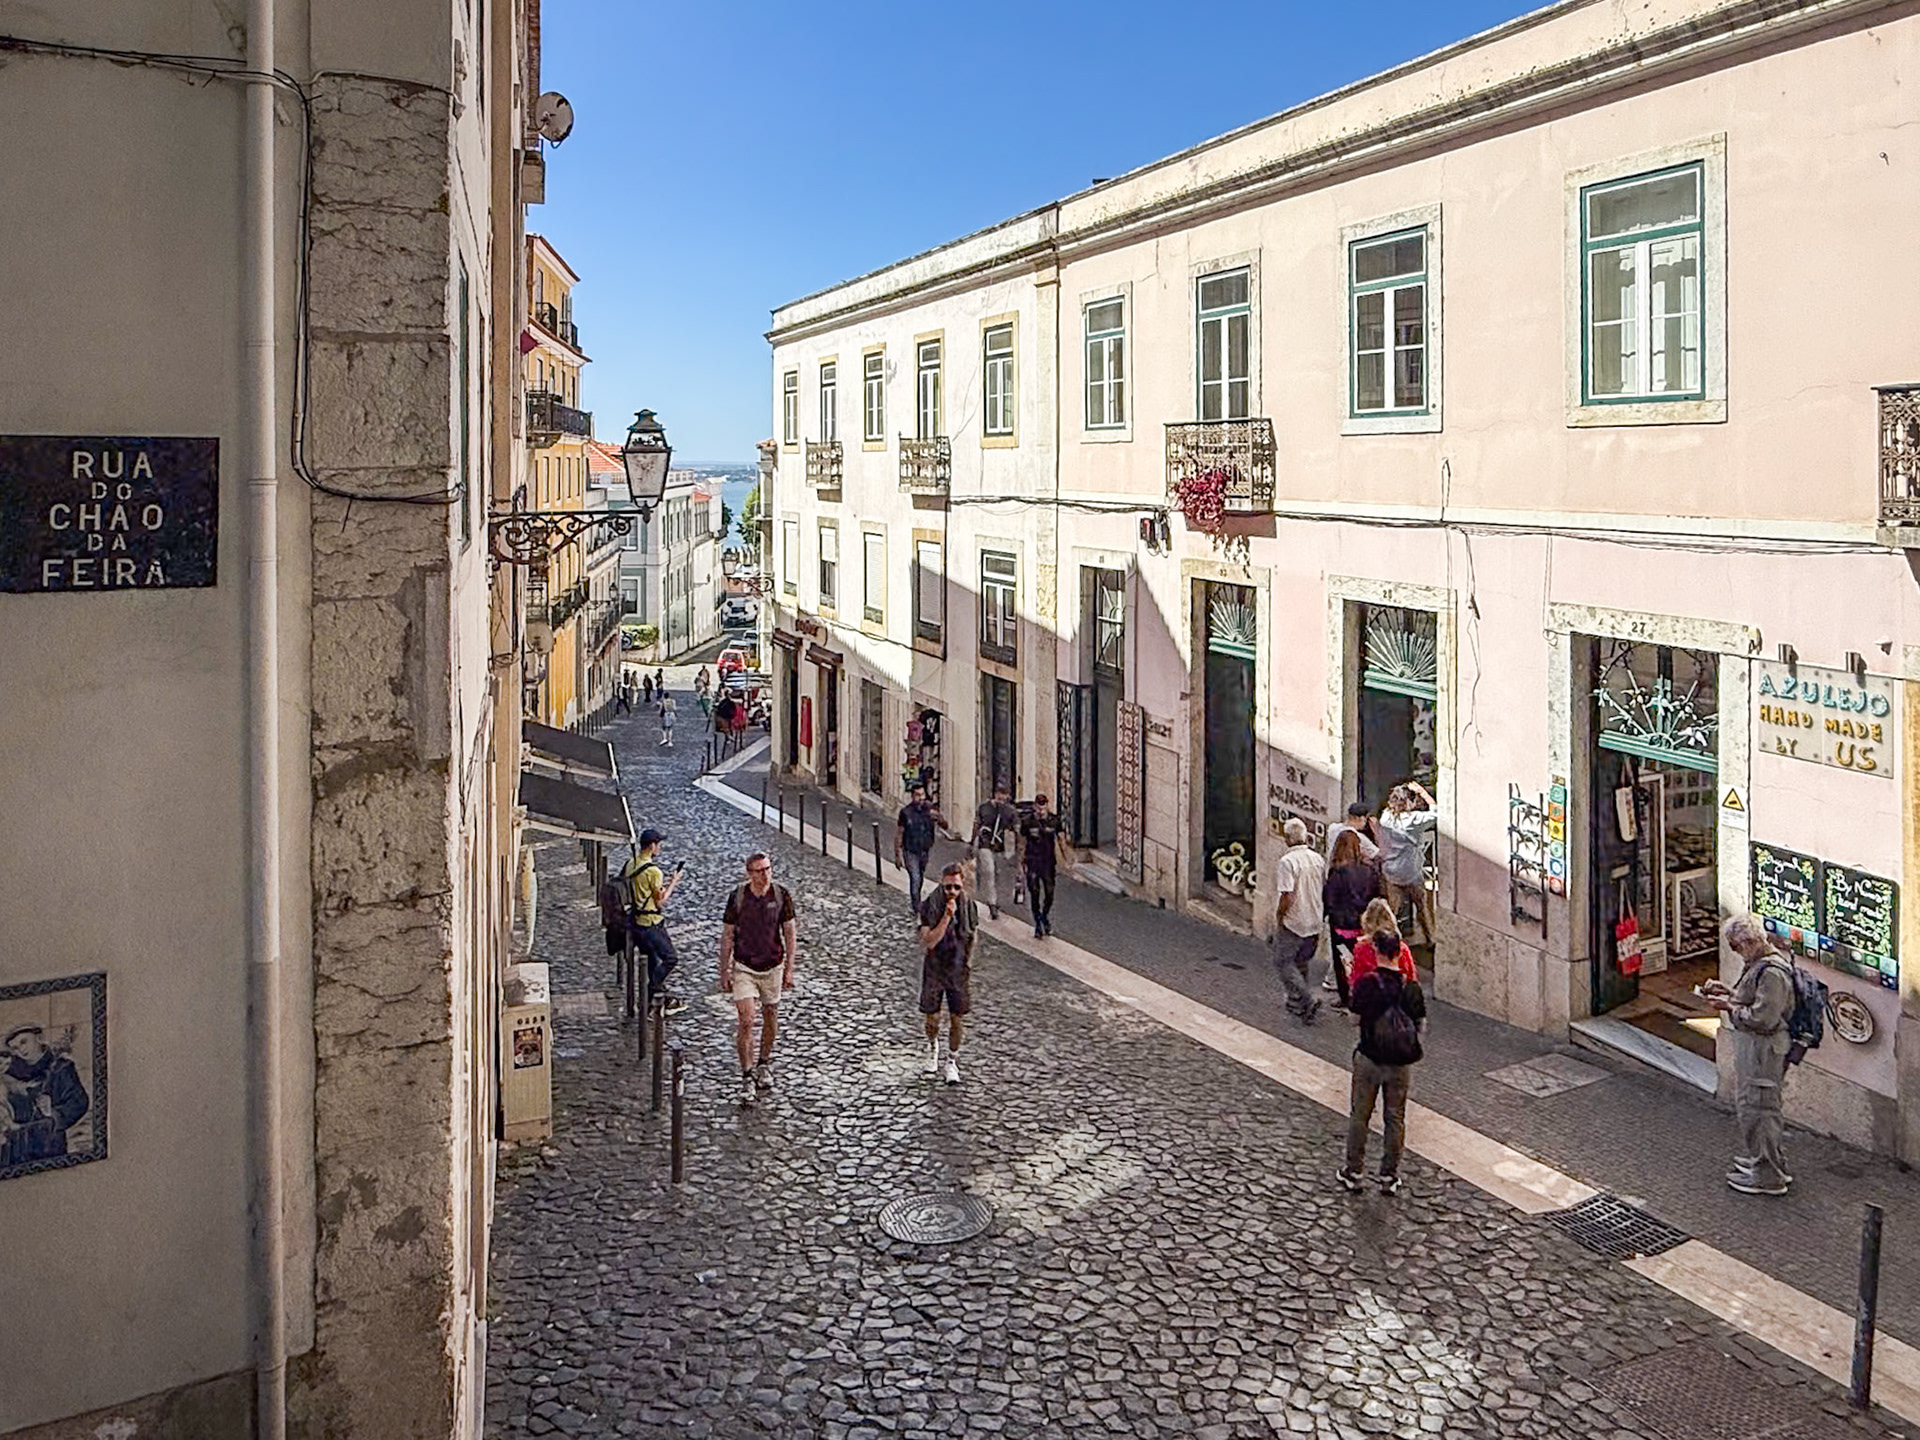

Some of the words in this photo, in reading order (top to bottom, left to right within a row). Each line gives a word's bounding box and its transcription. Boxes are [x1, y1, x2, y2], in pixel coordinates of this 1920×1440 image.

[72, 451, 153, 479] RUA
[91, 482, 132, 500] DO
[86, 533, 127, 551] DA
[42, 558, 165, 587] FEIRA
[1631, 621, 1647, 635] 27
[1758, 674, 1889, 716] AZULEJO
[1760, 705, 1813, 729] HAND
[1824, 718, 1883, 744] MADE
[1835, 741, 1878, 771] US
[1286, 765, 1309, 786] BY
